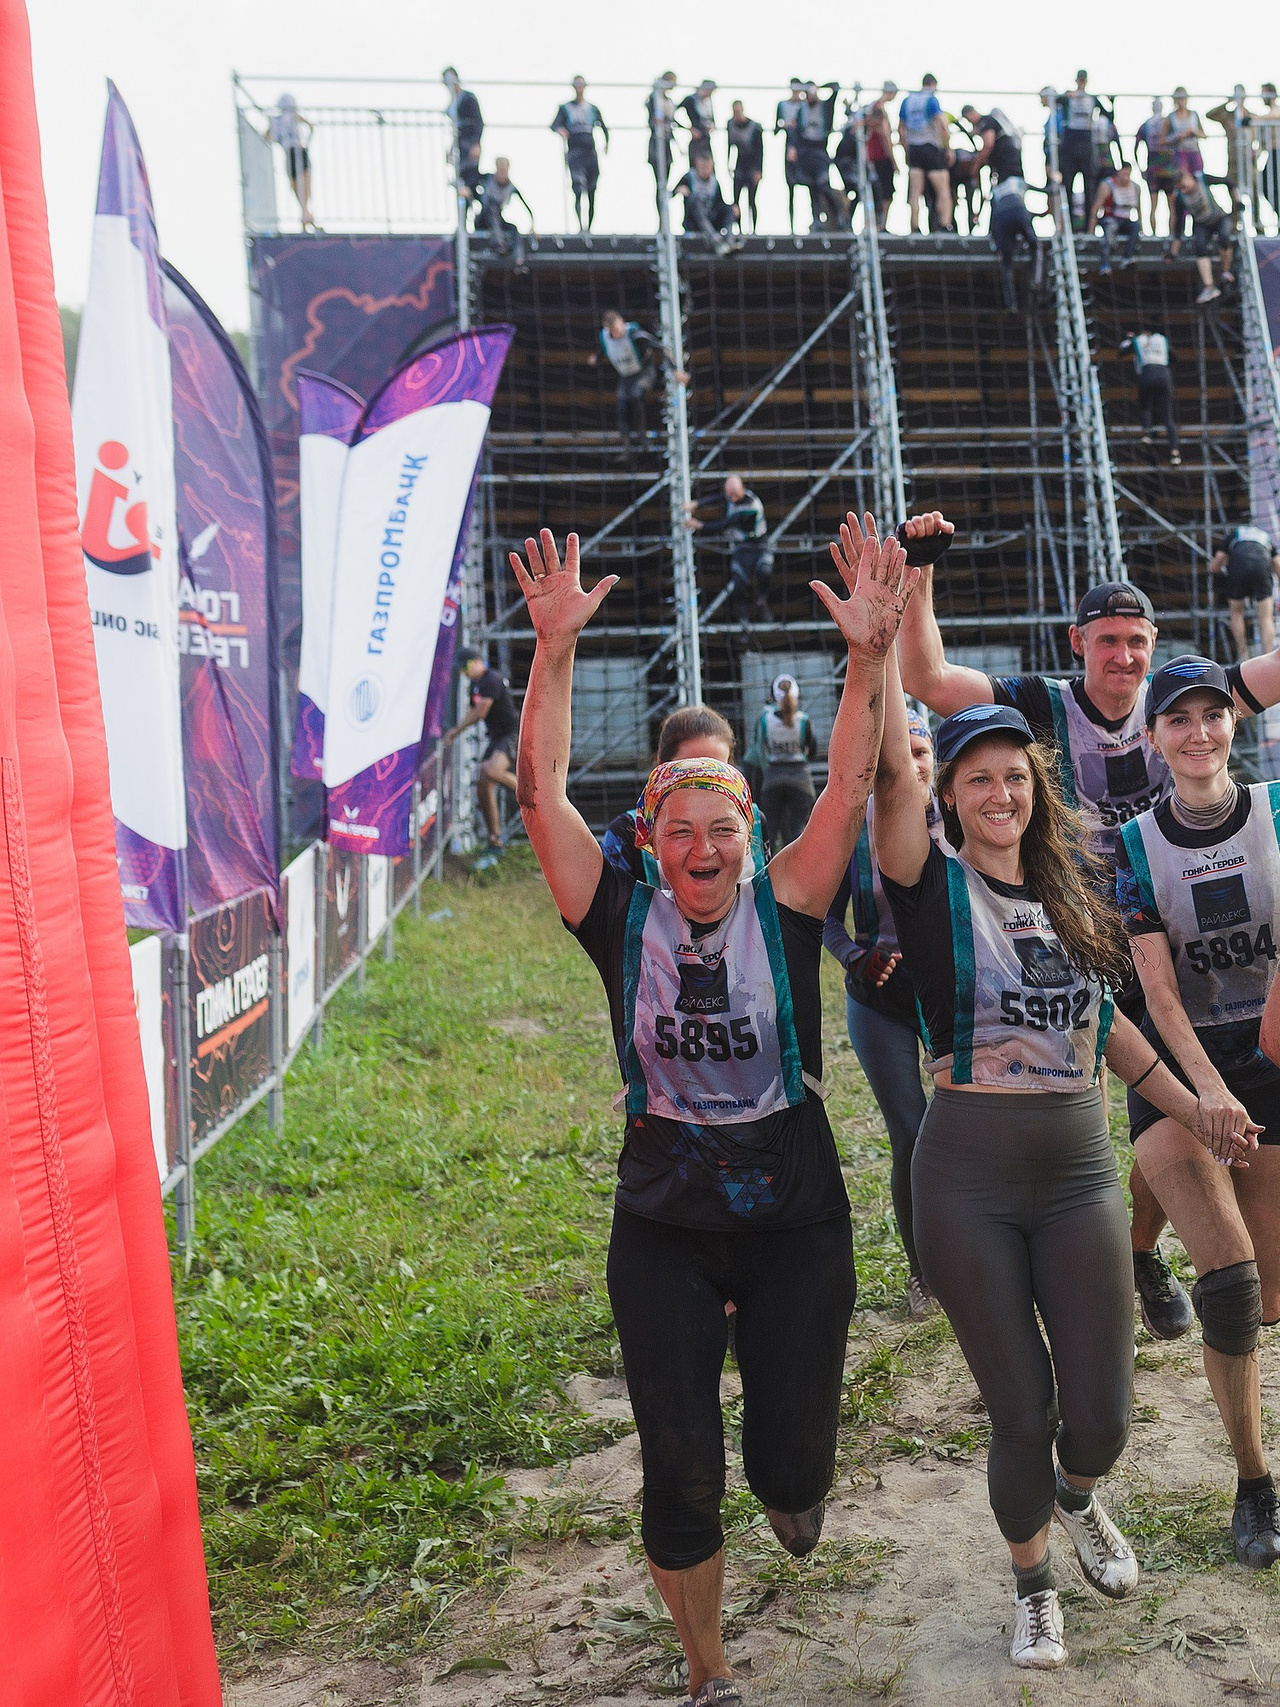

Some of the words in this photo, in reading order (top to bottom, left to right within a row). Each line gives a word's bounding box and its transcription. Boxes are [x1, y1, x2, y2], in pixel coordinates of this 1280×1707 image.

[1182, 864, 1212, 877] ГОНКА
[1212, 855, 1245, 870] ГЕРОЕВ
[1201, 908, 1247, 927] РАЙДЕКС
[1185, 923, 1278, 975] 5894
[1000, 989, 1091, 1031] 5902
[1224, 998, 1267, 1012] ГАЗПРОМБА
[655, 1015, 758, 1063] 5895
[1028, 1065, 1084, 1078] ГАЗПРОМБАНК
[692, 1098, 756, 1110] ГАЗПРОМБАНК
[696, 1686, 739, 1707] Rebok
